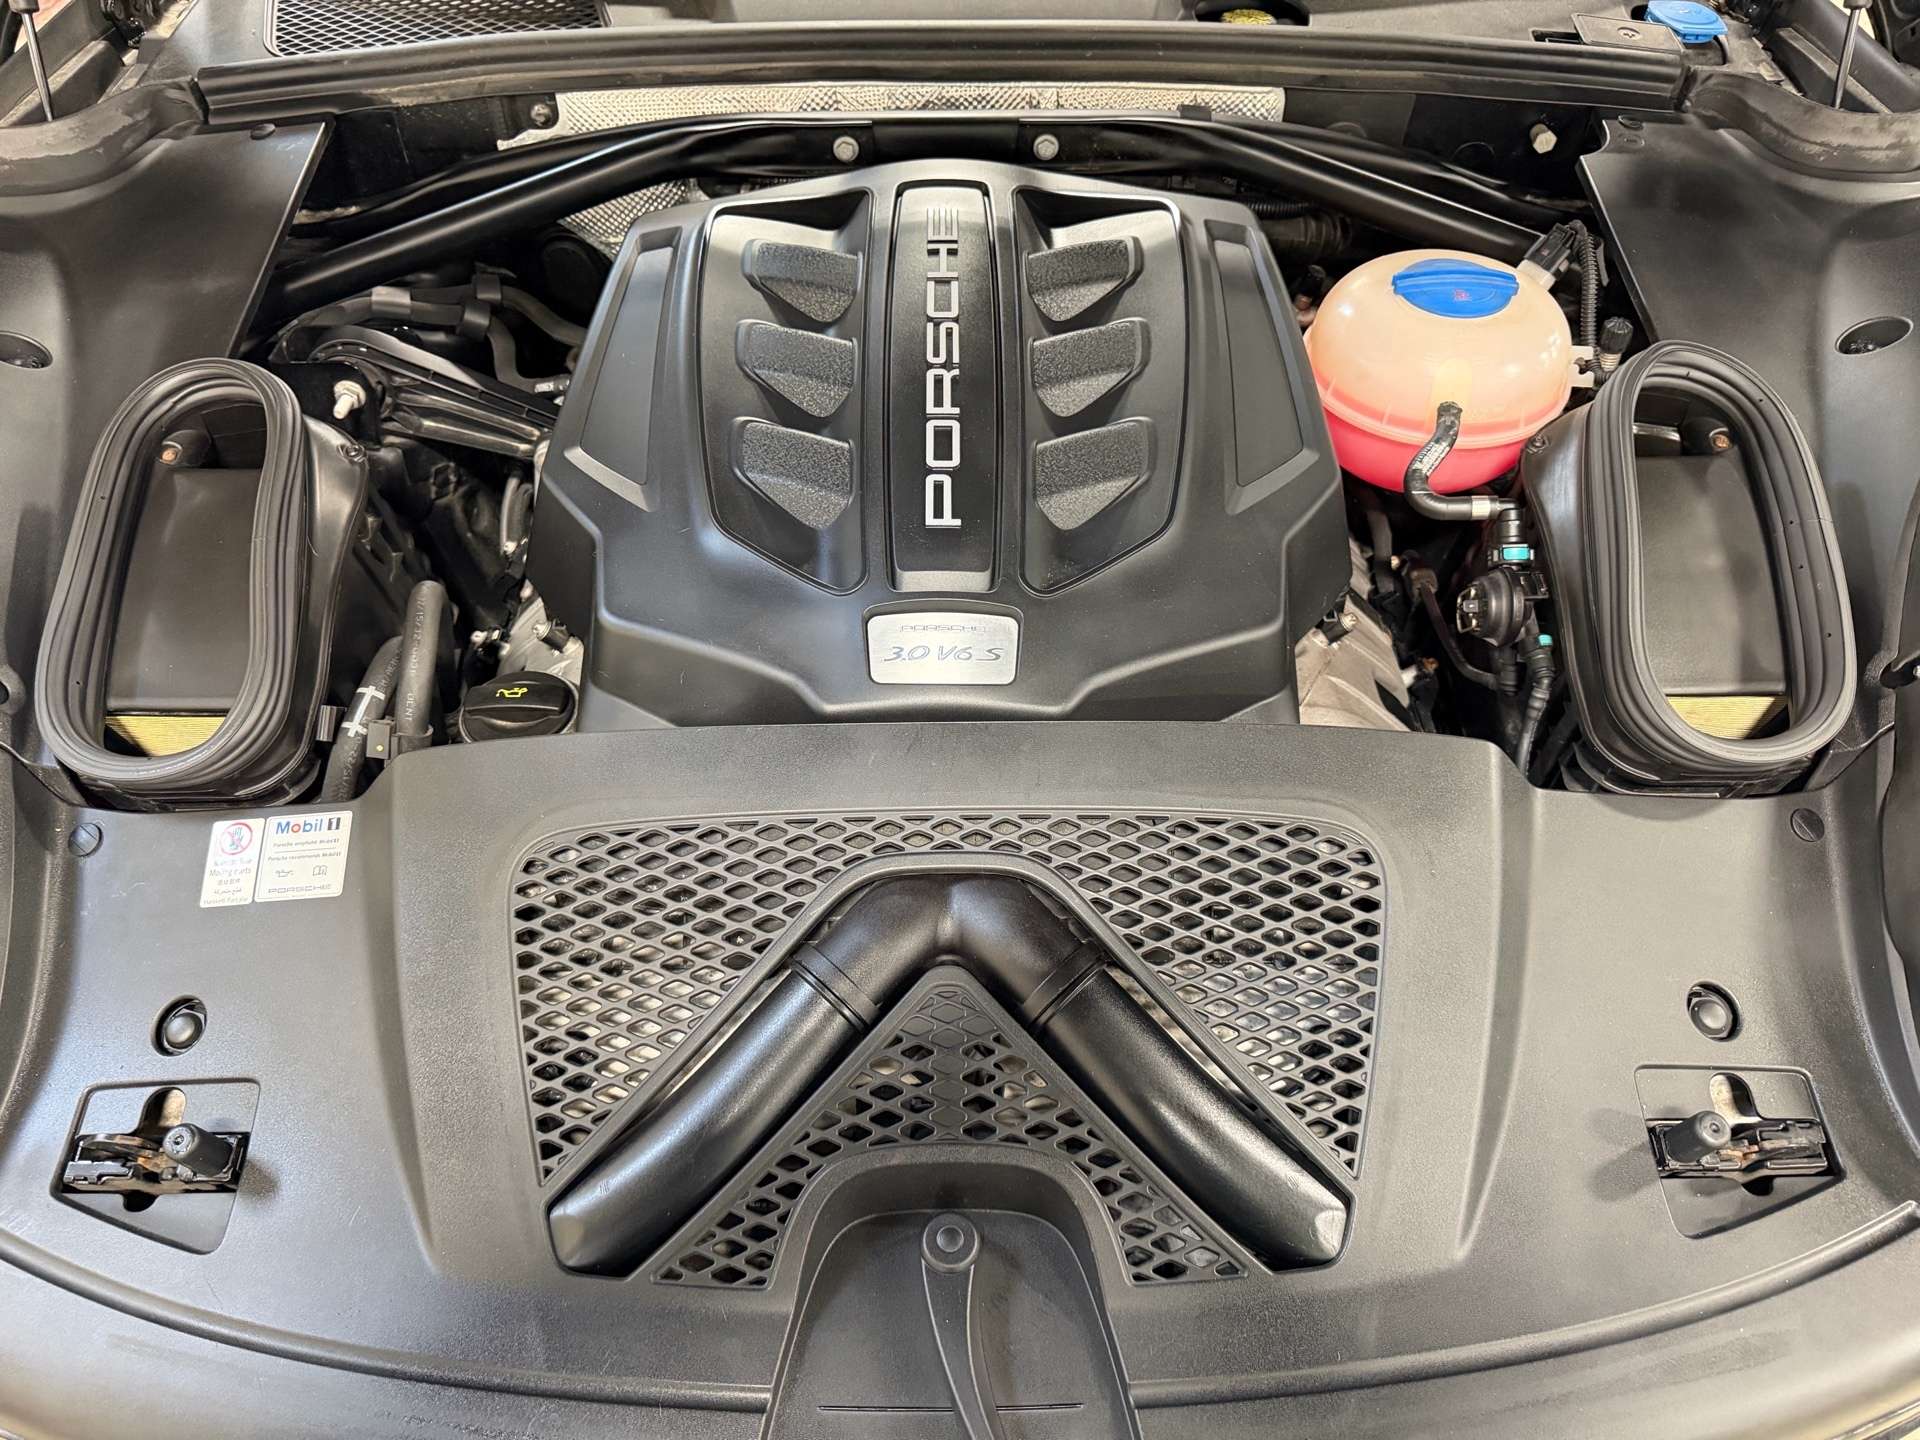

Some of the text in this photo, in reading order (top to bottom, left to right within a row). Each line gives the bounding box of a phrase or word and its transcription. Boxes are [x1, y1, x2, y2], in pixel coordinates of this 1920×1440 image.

[925, 207, 962, 529] PORSCHE
[883, 645, 1005, 662] 3.0 V6 S
[275, 817, 341, 835] Mobil 1
[267, 884, 331, 894] PORSCHE
